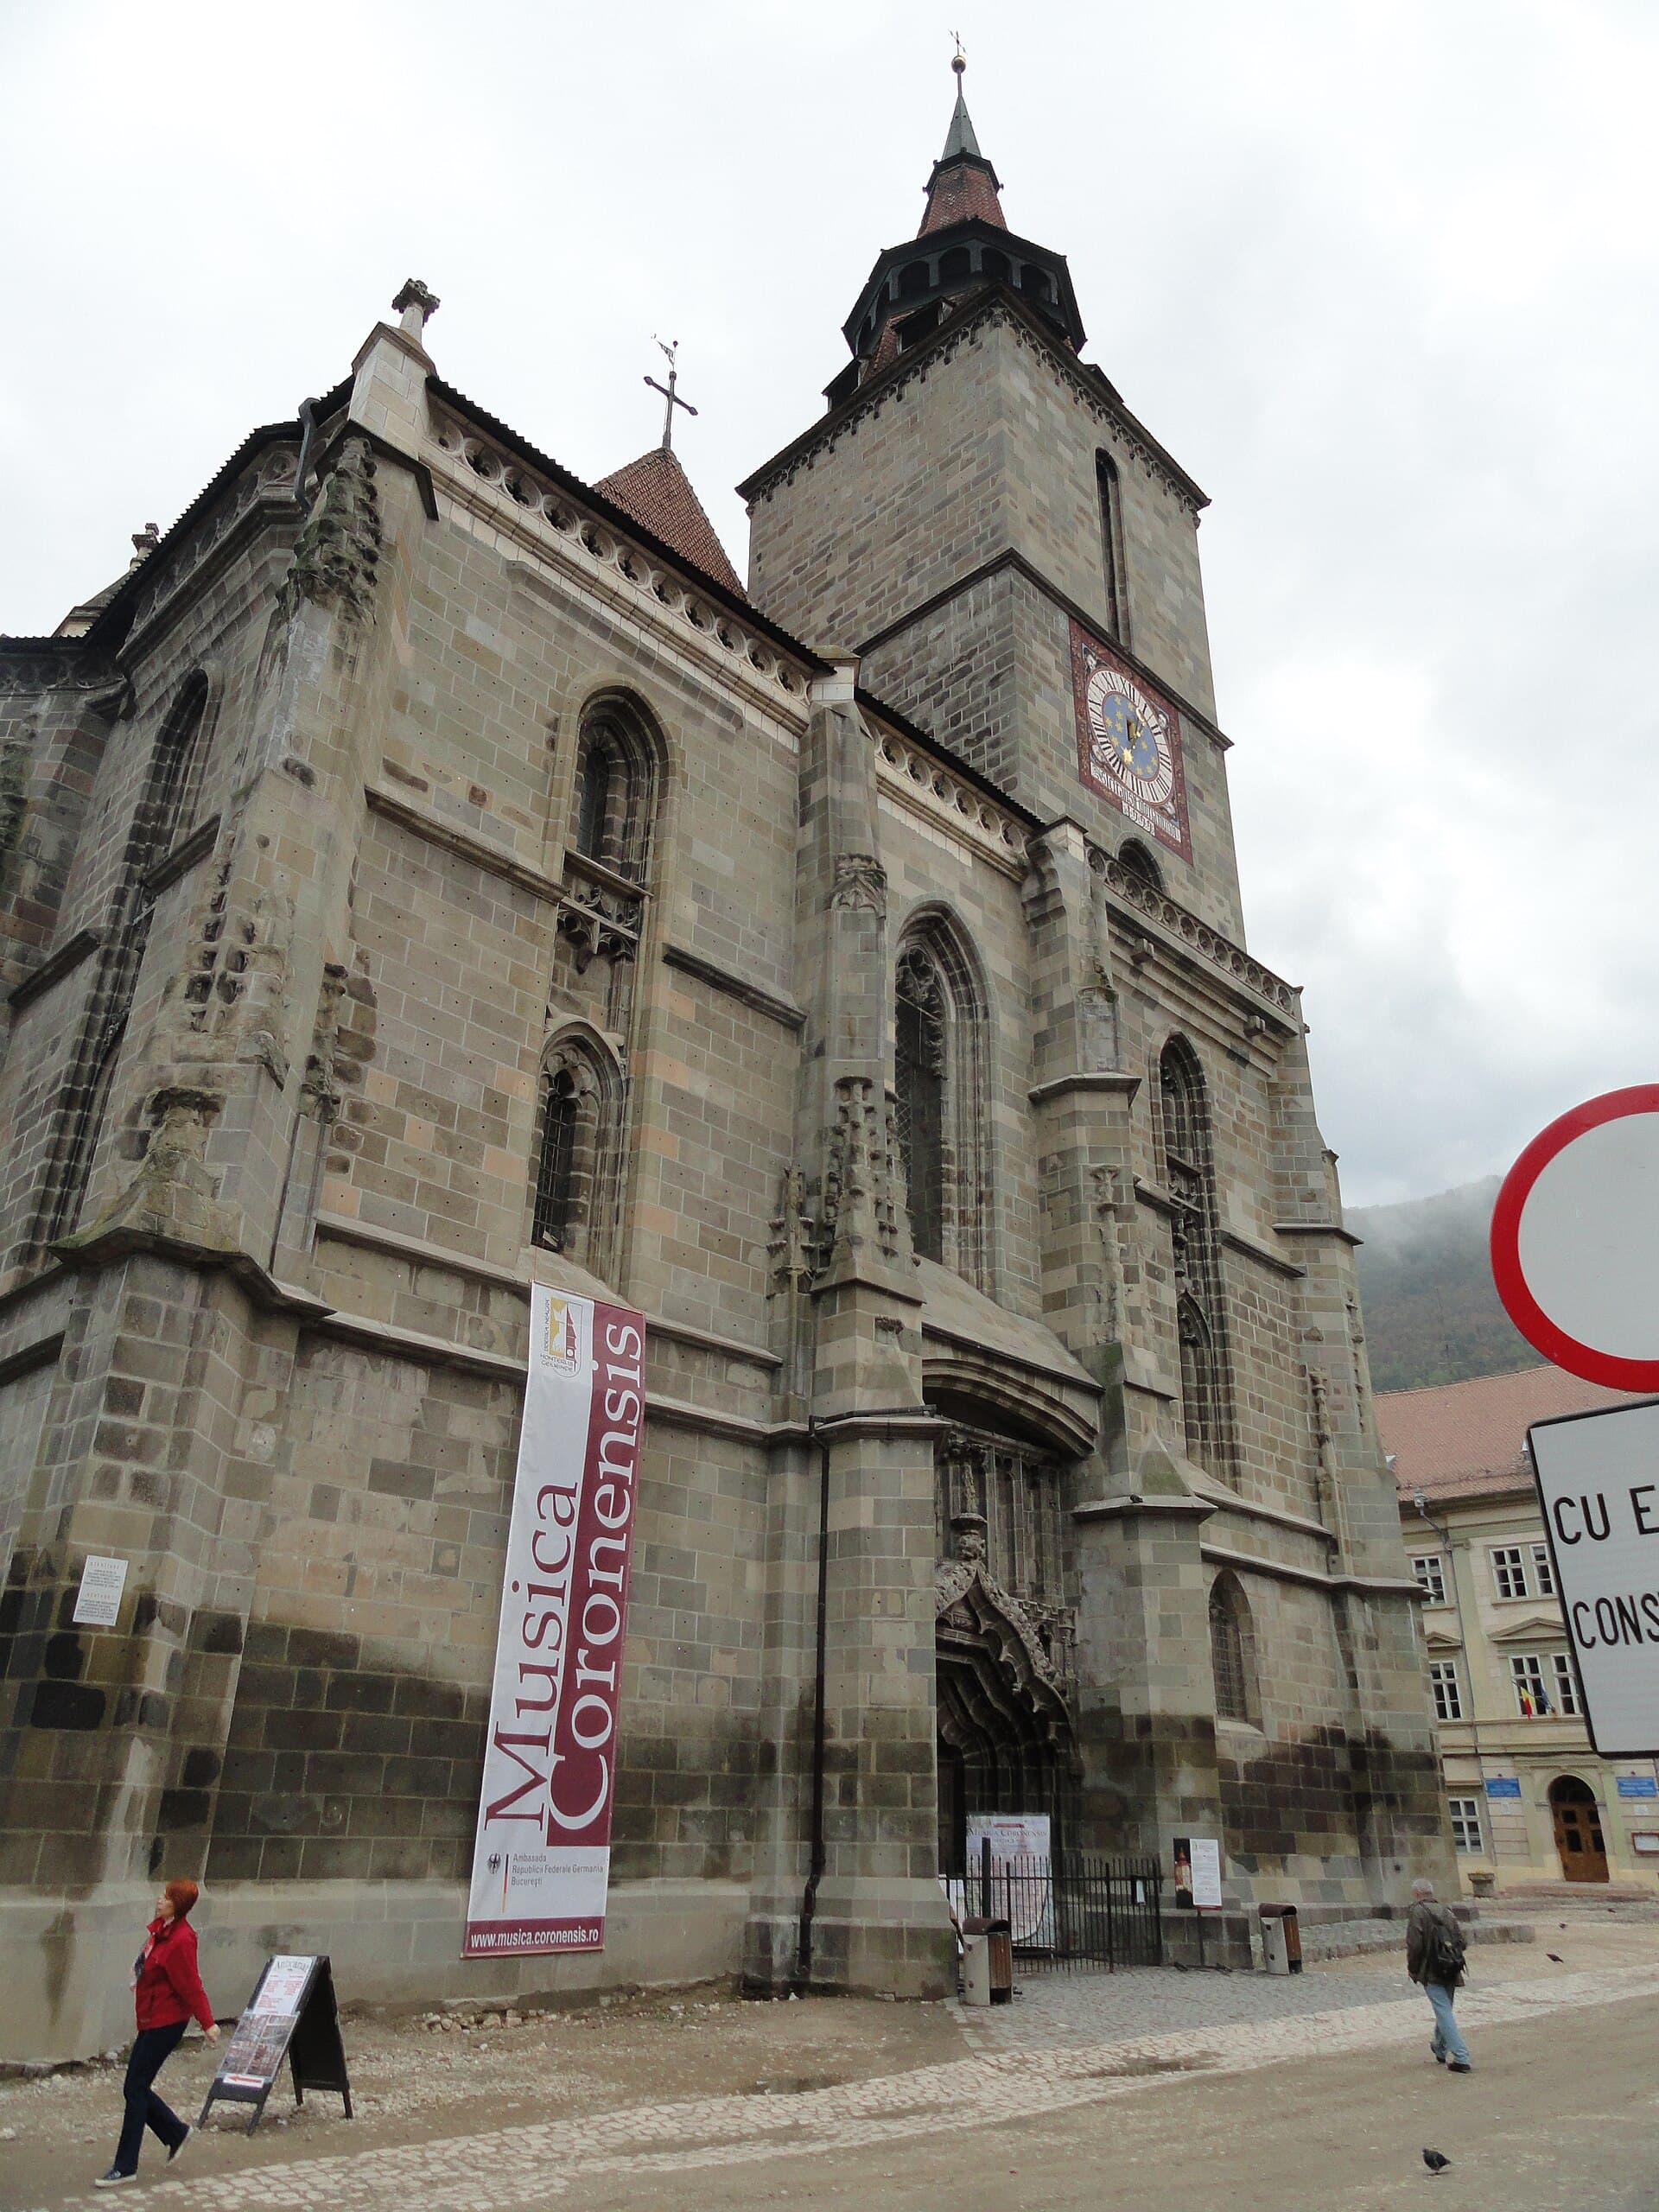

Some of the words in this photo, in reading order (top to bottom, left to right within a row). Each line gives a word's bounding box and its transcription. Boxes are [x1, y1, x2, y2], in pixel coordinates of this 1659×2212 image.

[1553, 1492, 1611, 1545] CU
[547, 1322, 643, 1831] Coronensis
[1572, 1592, 1659, 1649] CONS
[484, 1481, 578, 1833] Musica
[512, 1853, 547, 1862] Ambasada
[512, 1865, 543, 1875] Republicii
[544, 1865, 571, 1873] Federale
[572, 1864, 603, 1873] Germania
[470, 1926, 599, 1948] www.musica.coronensis.ro
